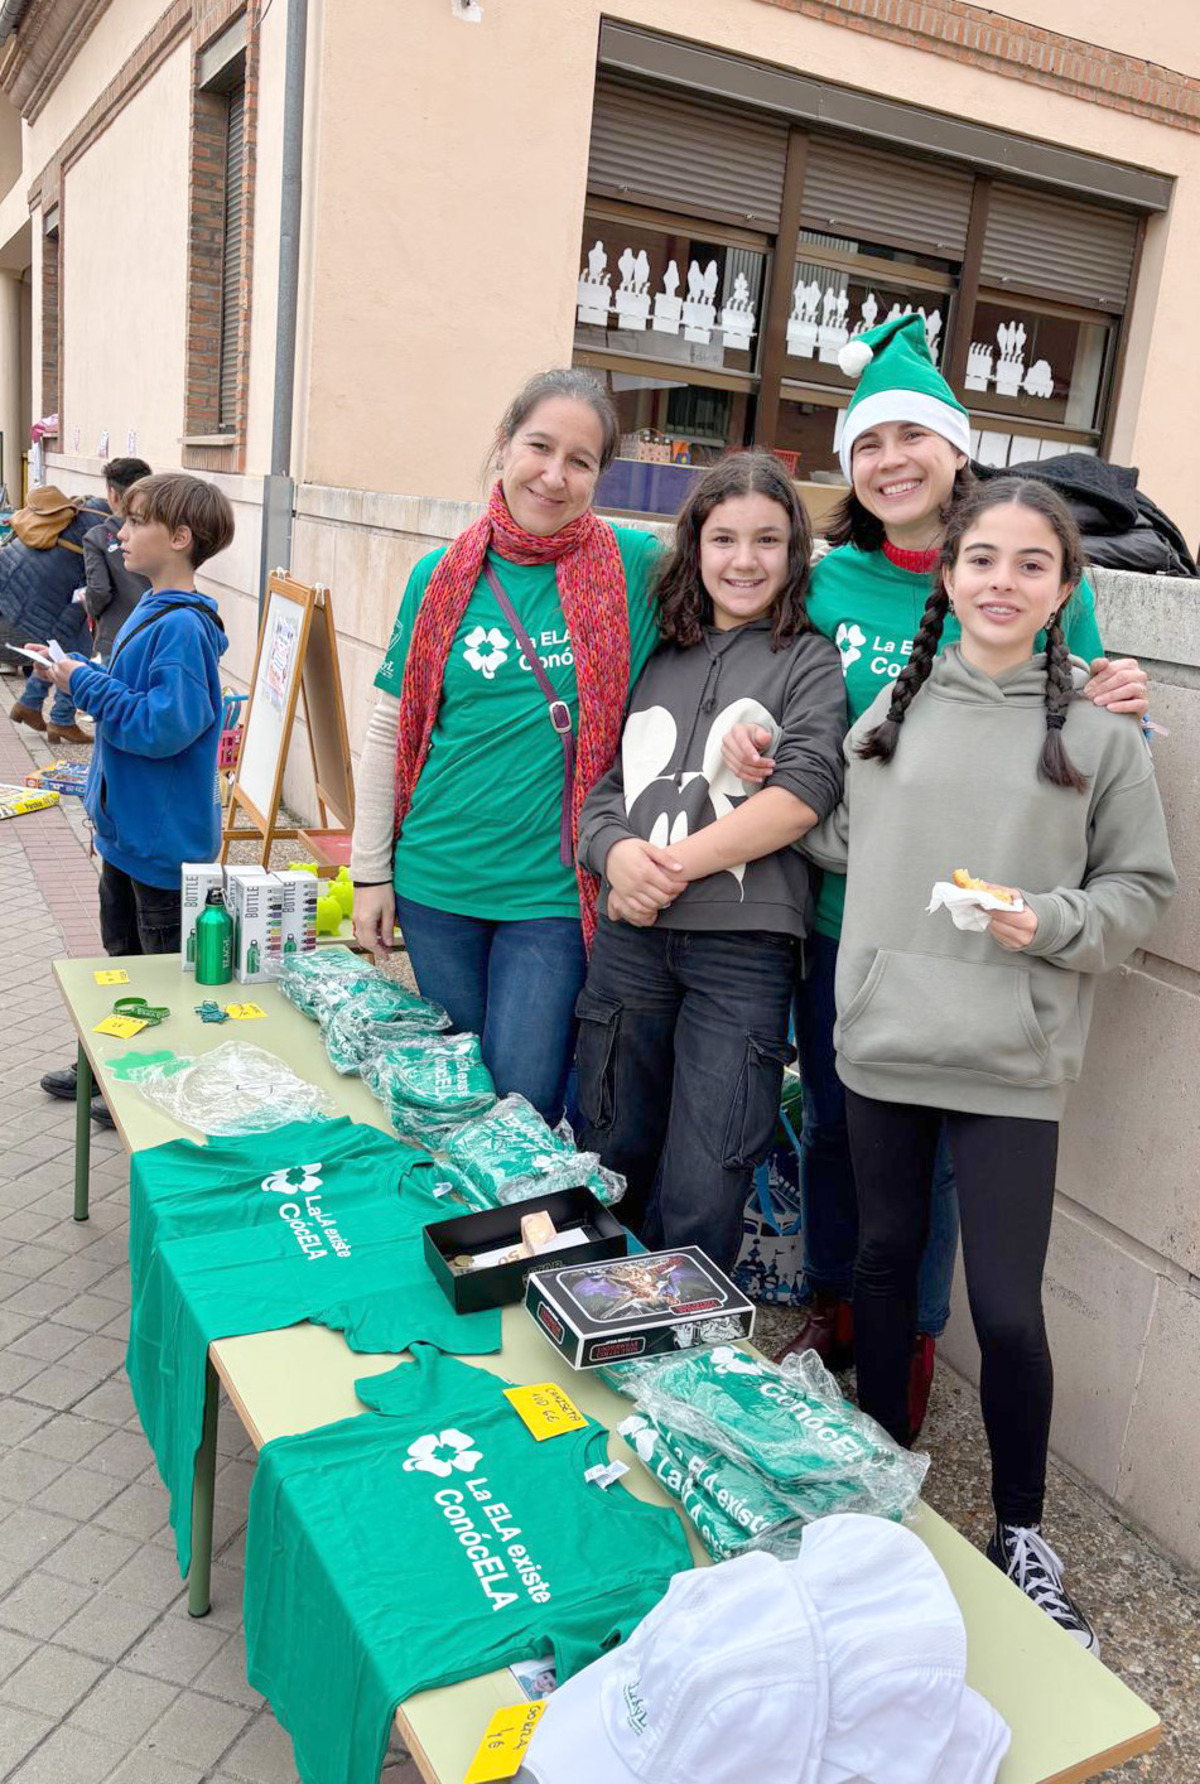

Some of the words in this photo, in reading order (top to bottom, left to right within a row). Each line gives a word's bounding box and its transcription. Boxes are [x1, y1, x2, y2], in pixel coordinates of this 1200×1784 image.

[872, 635, 896, 653] La
[870, 656, 908, 678] Co
[184, 876, 199, 908] BOTTLE
[245, 886, 260, 919] BOTTLE
[282, 881, 296, 913] BOTTLE
[323, 1227, 351, 1258] existe
[433, 1488, 520, 1612] ConócELA
[465, 1477, 492, 1502] La
[482, 1502, 522, 1543] ELA
[506, 1543, 551, 1604] existe
